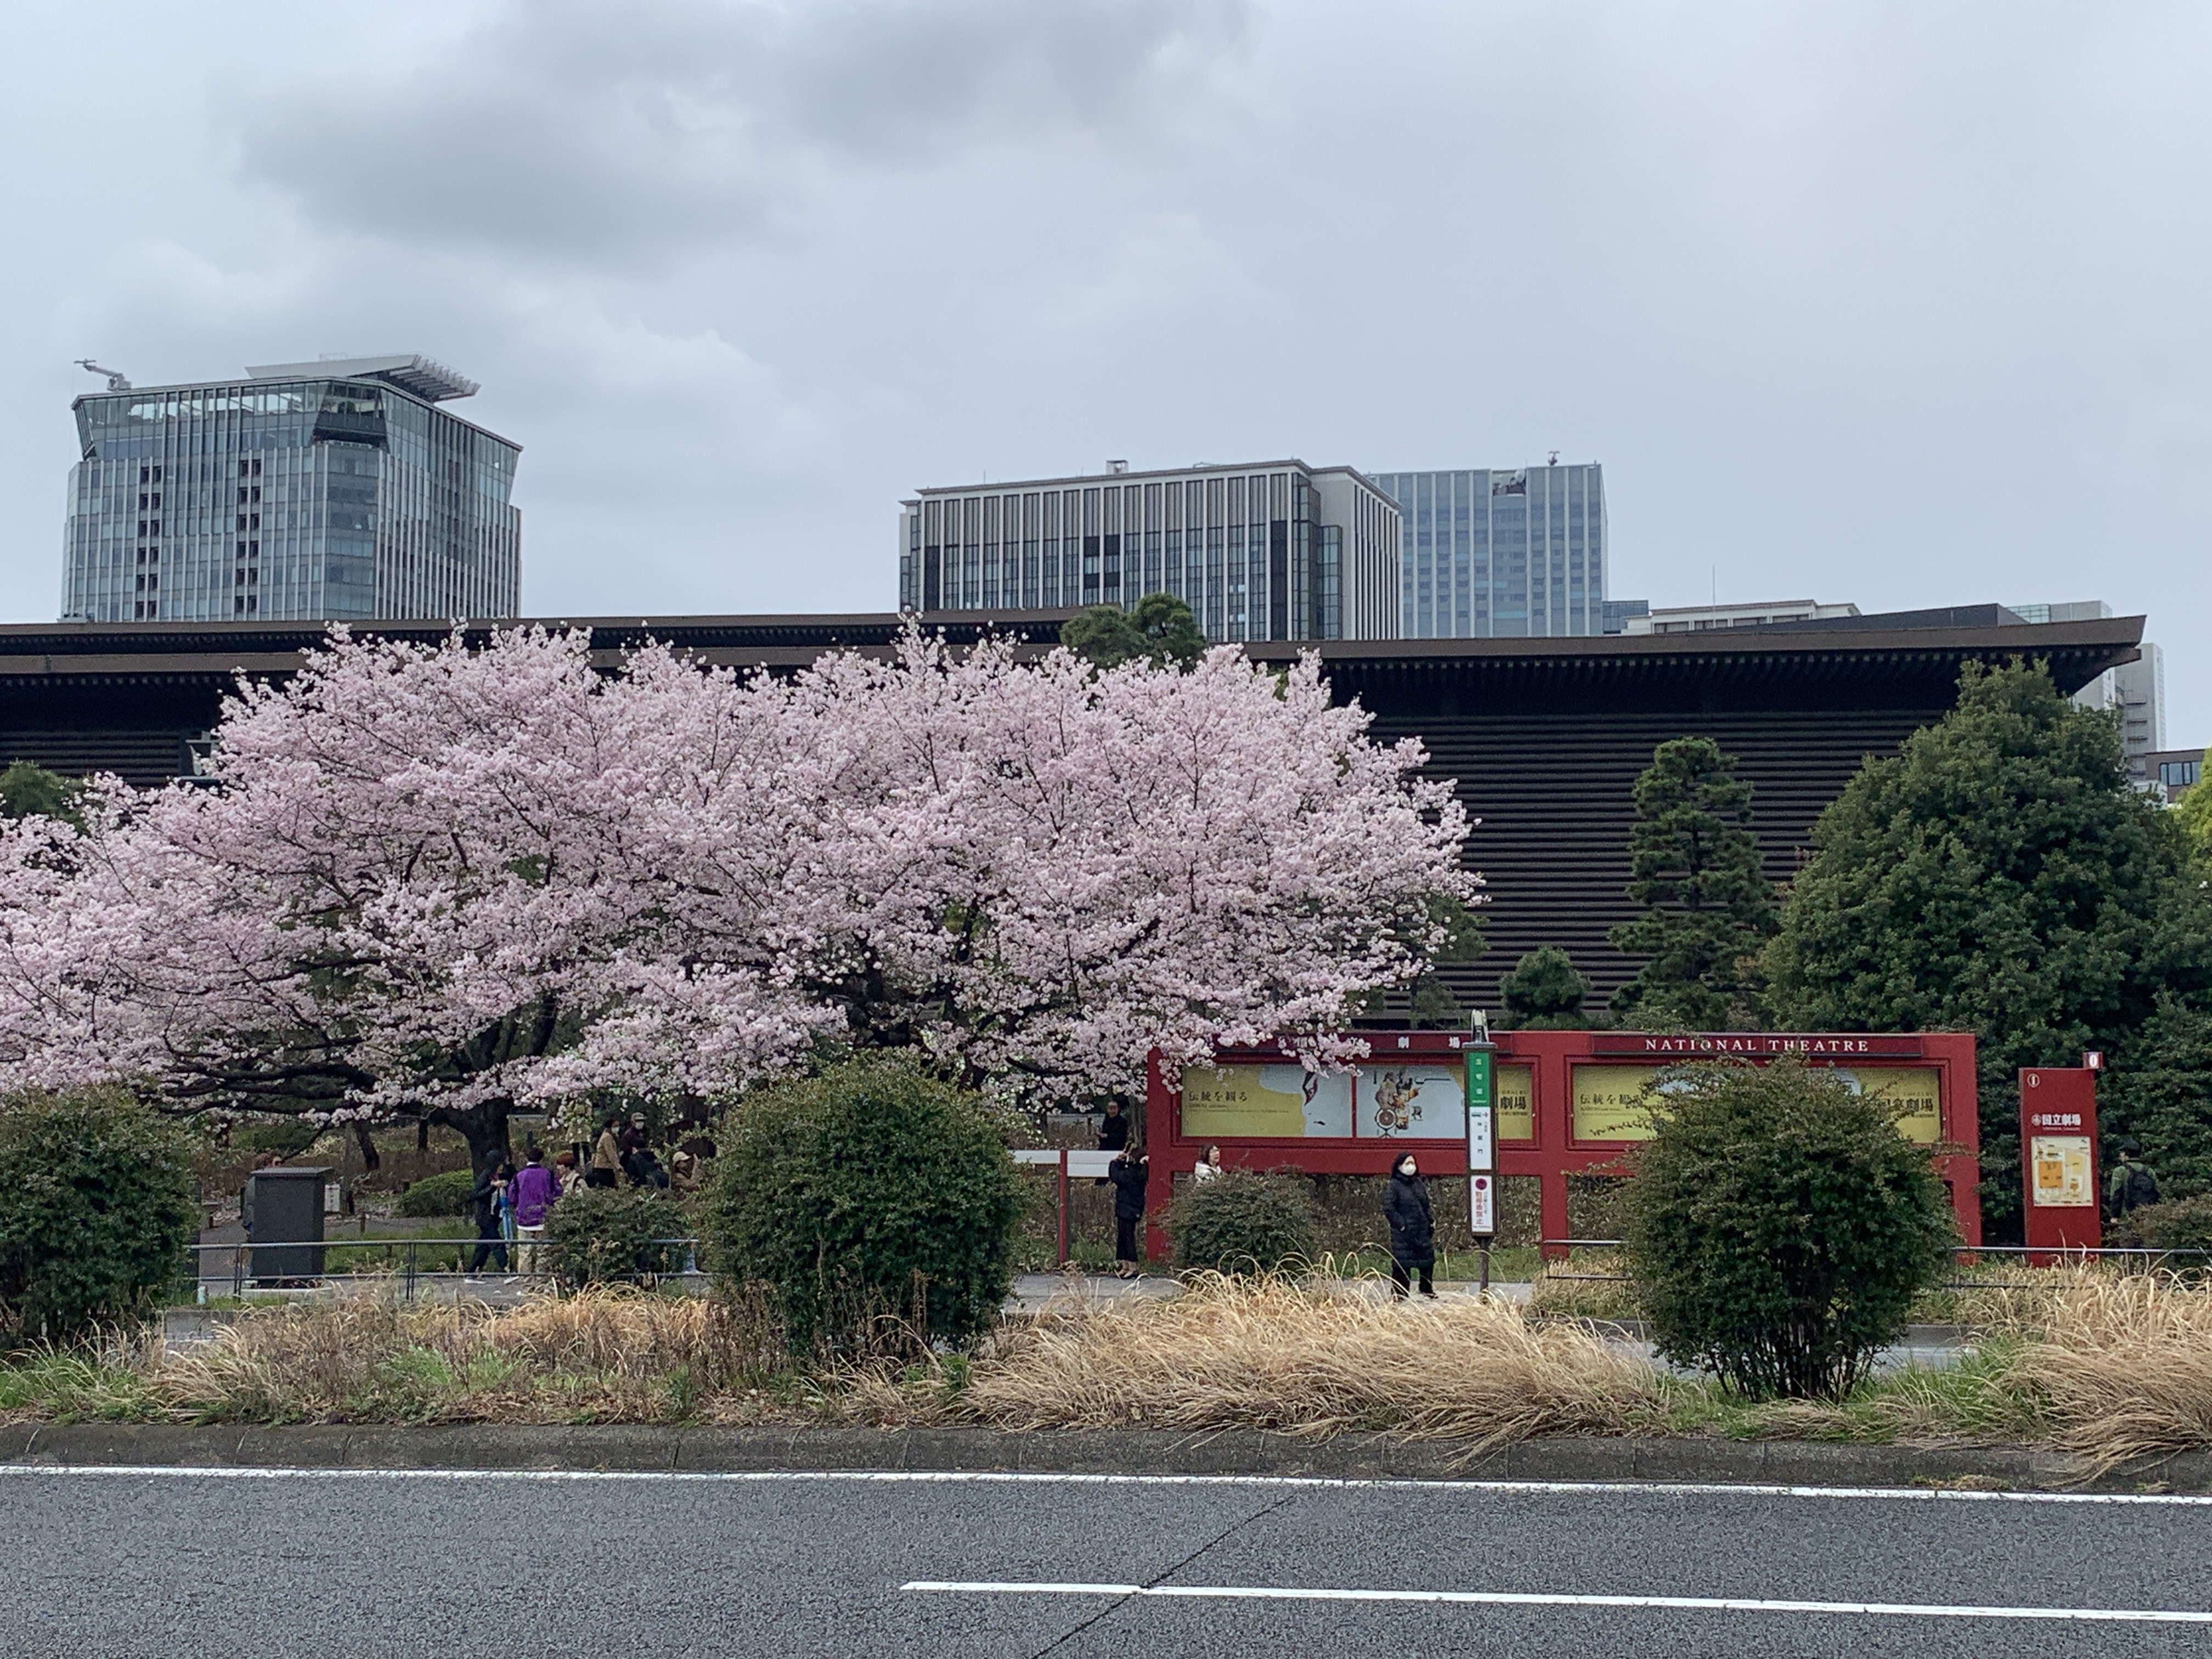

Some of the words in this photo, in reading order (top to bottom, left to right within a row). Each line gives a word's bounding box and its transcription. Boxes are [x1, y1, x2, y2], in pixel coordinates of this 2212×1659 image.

[1645, 1039, 1757, 1051] NATIONAL
[1768, 1040, 1869, 1052] THEATRE
[2042, 1113, 2081, 1126] 国立劇場
